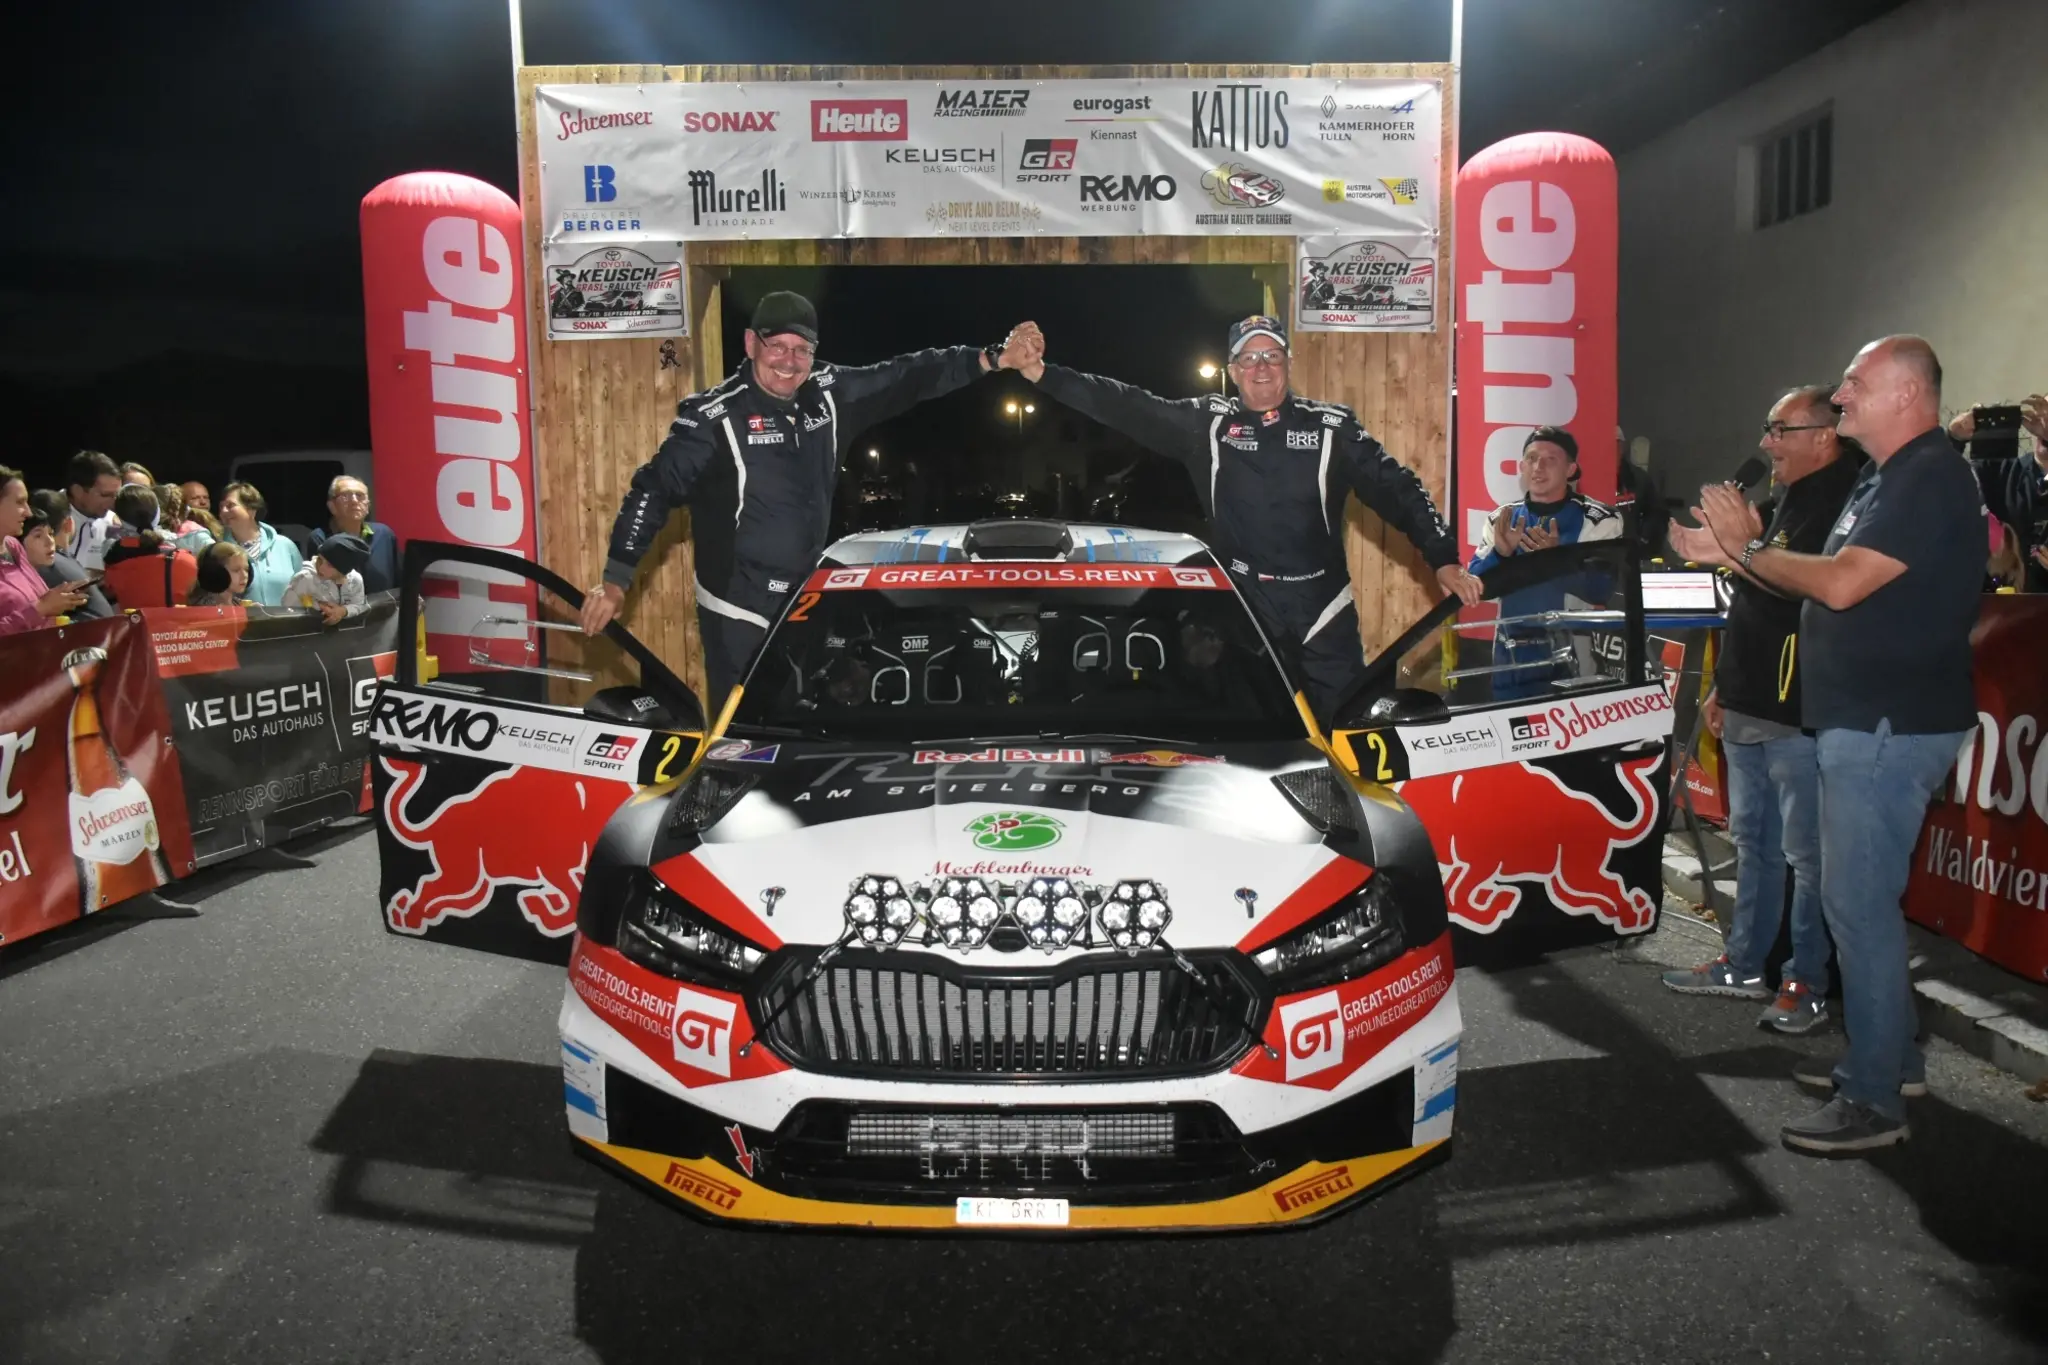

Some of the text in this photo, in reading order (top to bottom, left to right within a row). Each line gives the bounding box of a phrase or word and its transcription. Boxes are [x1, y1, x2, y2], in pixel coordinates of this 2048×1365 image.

[936, 90, 1030, 109] MAIER
[1073, 94, 1151, 112] eurogast
[819, 108, 901, 133] Heute
[934, 109, 980, 117] RACING
[1192, 85, 1289, 151] KATTUS
[557, 111, 653, 141] Schremser
[684, 111, 777, 133] SONAX
[1319, 122, 1415, 131] KAMMERHOFER
[1090, 130, 1137, 141] Kiennast
[1320, 132, 1415, 141] TULLN HORN
[886, 148, 995, 163] KEUSCH
[1023, 151, 1075, 169] GR
[923, 164, 995, 173] DAS AUTOHAUS
[1016, 174, 1071, 182] SPORT
[1081, 174, 1177, 201] REMO
[688, 168, 786, 226] Murelli
[948, 201, 1020, 218] DRIVE AND RELAX
[1081, 204, 1136, 212] WERBUNG
[564, 220, 640, 231] BERGER
[707, 218, 775, 226] LIMONADE
[949, 221, 1020, 231] NEXT LEVEL EVENTS
[1196, 214, 1292, 225] AUSTRIAN RALLYE CHALLENGE
[577, 267, 658, 282] KEUSCH
[1330, 262, 1411, 275] KEUSCH
[573, 321, 607, 329] SONAX
[1322, 314, 1357, 322] SONAX
[748, 433, 784, 445] PIRELLI
[1286, 434, 1319, 446] BRR
[830, 569, 1209, 583] GT GREAT-TOOLS.RENT GT
[768, 580, 789, 592] OMP
[787, 592, 821, 621] 2
[152, 631, 208, 641] TOYOTA KEUSCH
[902, 637, 929, 651] OMP
[973, 639, 992, 648] OMP
[185, 681, 322, 731] KEUSCH
[233, 712, 324, 743] DAS AUTOHAUS
[370, 695, 499, 751] REMO
[1550, 690, 1672, 750] Schremser
[496, 724, 575, 746] KEUSCH
[1411, 728, 1494, 751] KEUSCH
[1513, 722, 1550, 740] GR
[518, 740, 570, 755] DAS AUTOHAUS
[591, 741, 629, 760] GR
[1444, 741, 1497, 755] DAS AUTOHAUS
[1511, 740, 1550, 752] SPORT
[655, 736, 681, 782] 2
[913, 748, 1085, 764] Red Bull
[1366, 733, 1393, 781] 2
[584, 759, 624, 771] SPORT
[793, 783, 1140, 801] AM SPIELBERG
[79, 801, 148, 846] Schremser
[925, 860, 1094, 877] Mecklenburger
[578, 955, 675, 1020] GREAT-TOOLS.RENT
[1343, 956, 1442, 1021] GREAT-TOOLS.RENT
[1347, 976, 1448, 1041] #YOUNEEDGREATTOOLS
[676, 1009, 729, 1057] GT
[1290, 1009, 1339, 1060] GT
[663, 1161, 742, 1210] PIRELLI
[1273, 1165, 1353, 1213] PIRELLI
